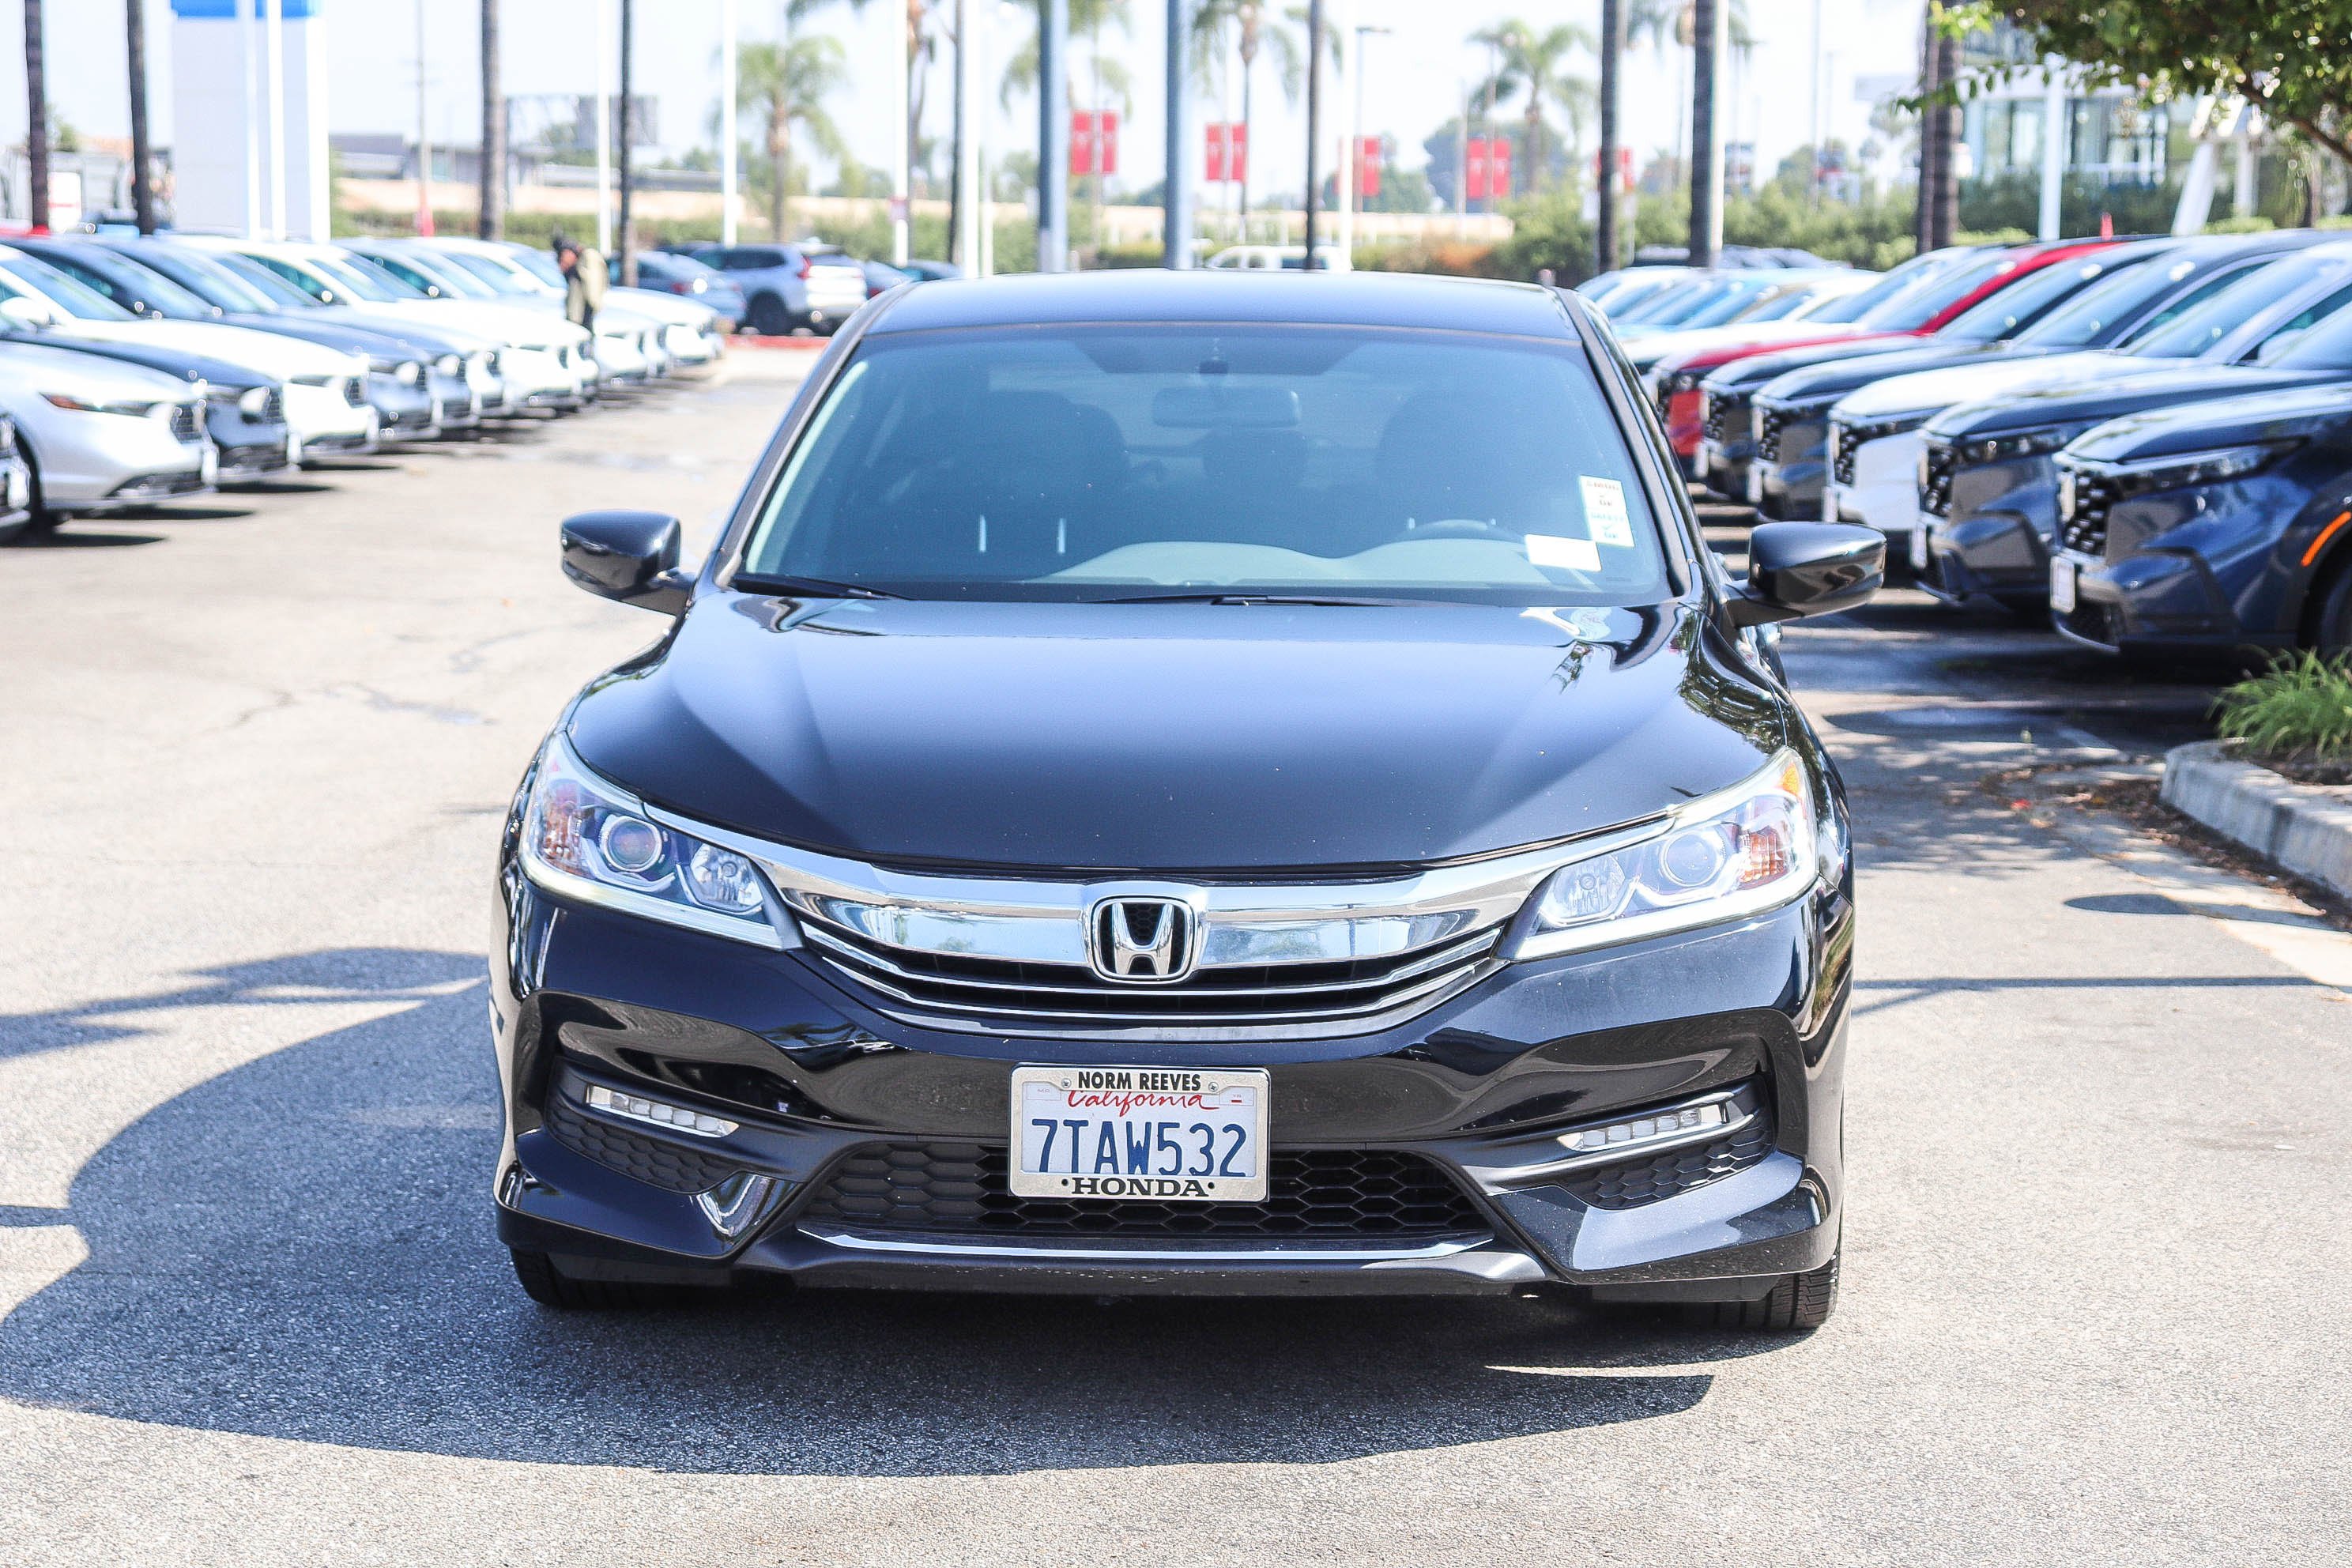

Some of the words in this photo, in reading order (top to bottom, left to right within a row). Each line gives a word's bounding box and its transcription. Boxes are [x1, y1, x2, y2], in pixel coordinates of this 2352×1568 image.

[1078, 1071, 1133, 1090] NORM
[1139, 1072, 1201, 1091] REEVES
[1068, 1090, 1219, 1118] California
[1031, 1118, 1247, 1177] 7TAW532
[1071, 1177, 1209, 1197] HONDA
